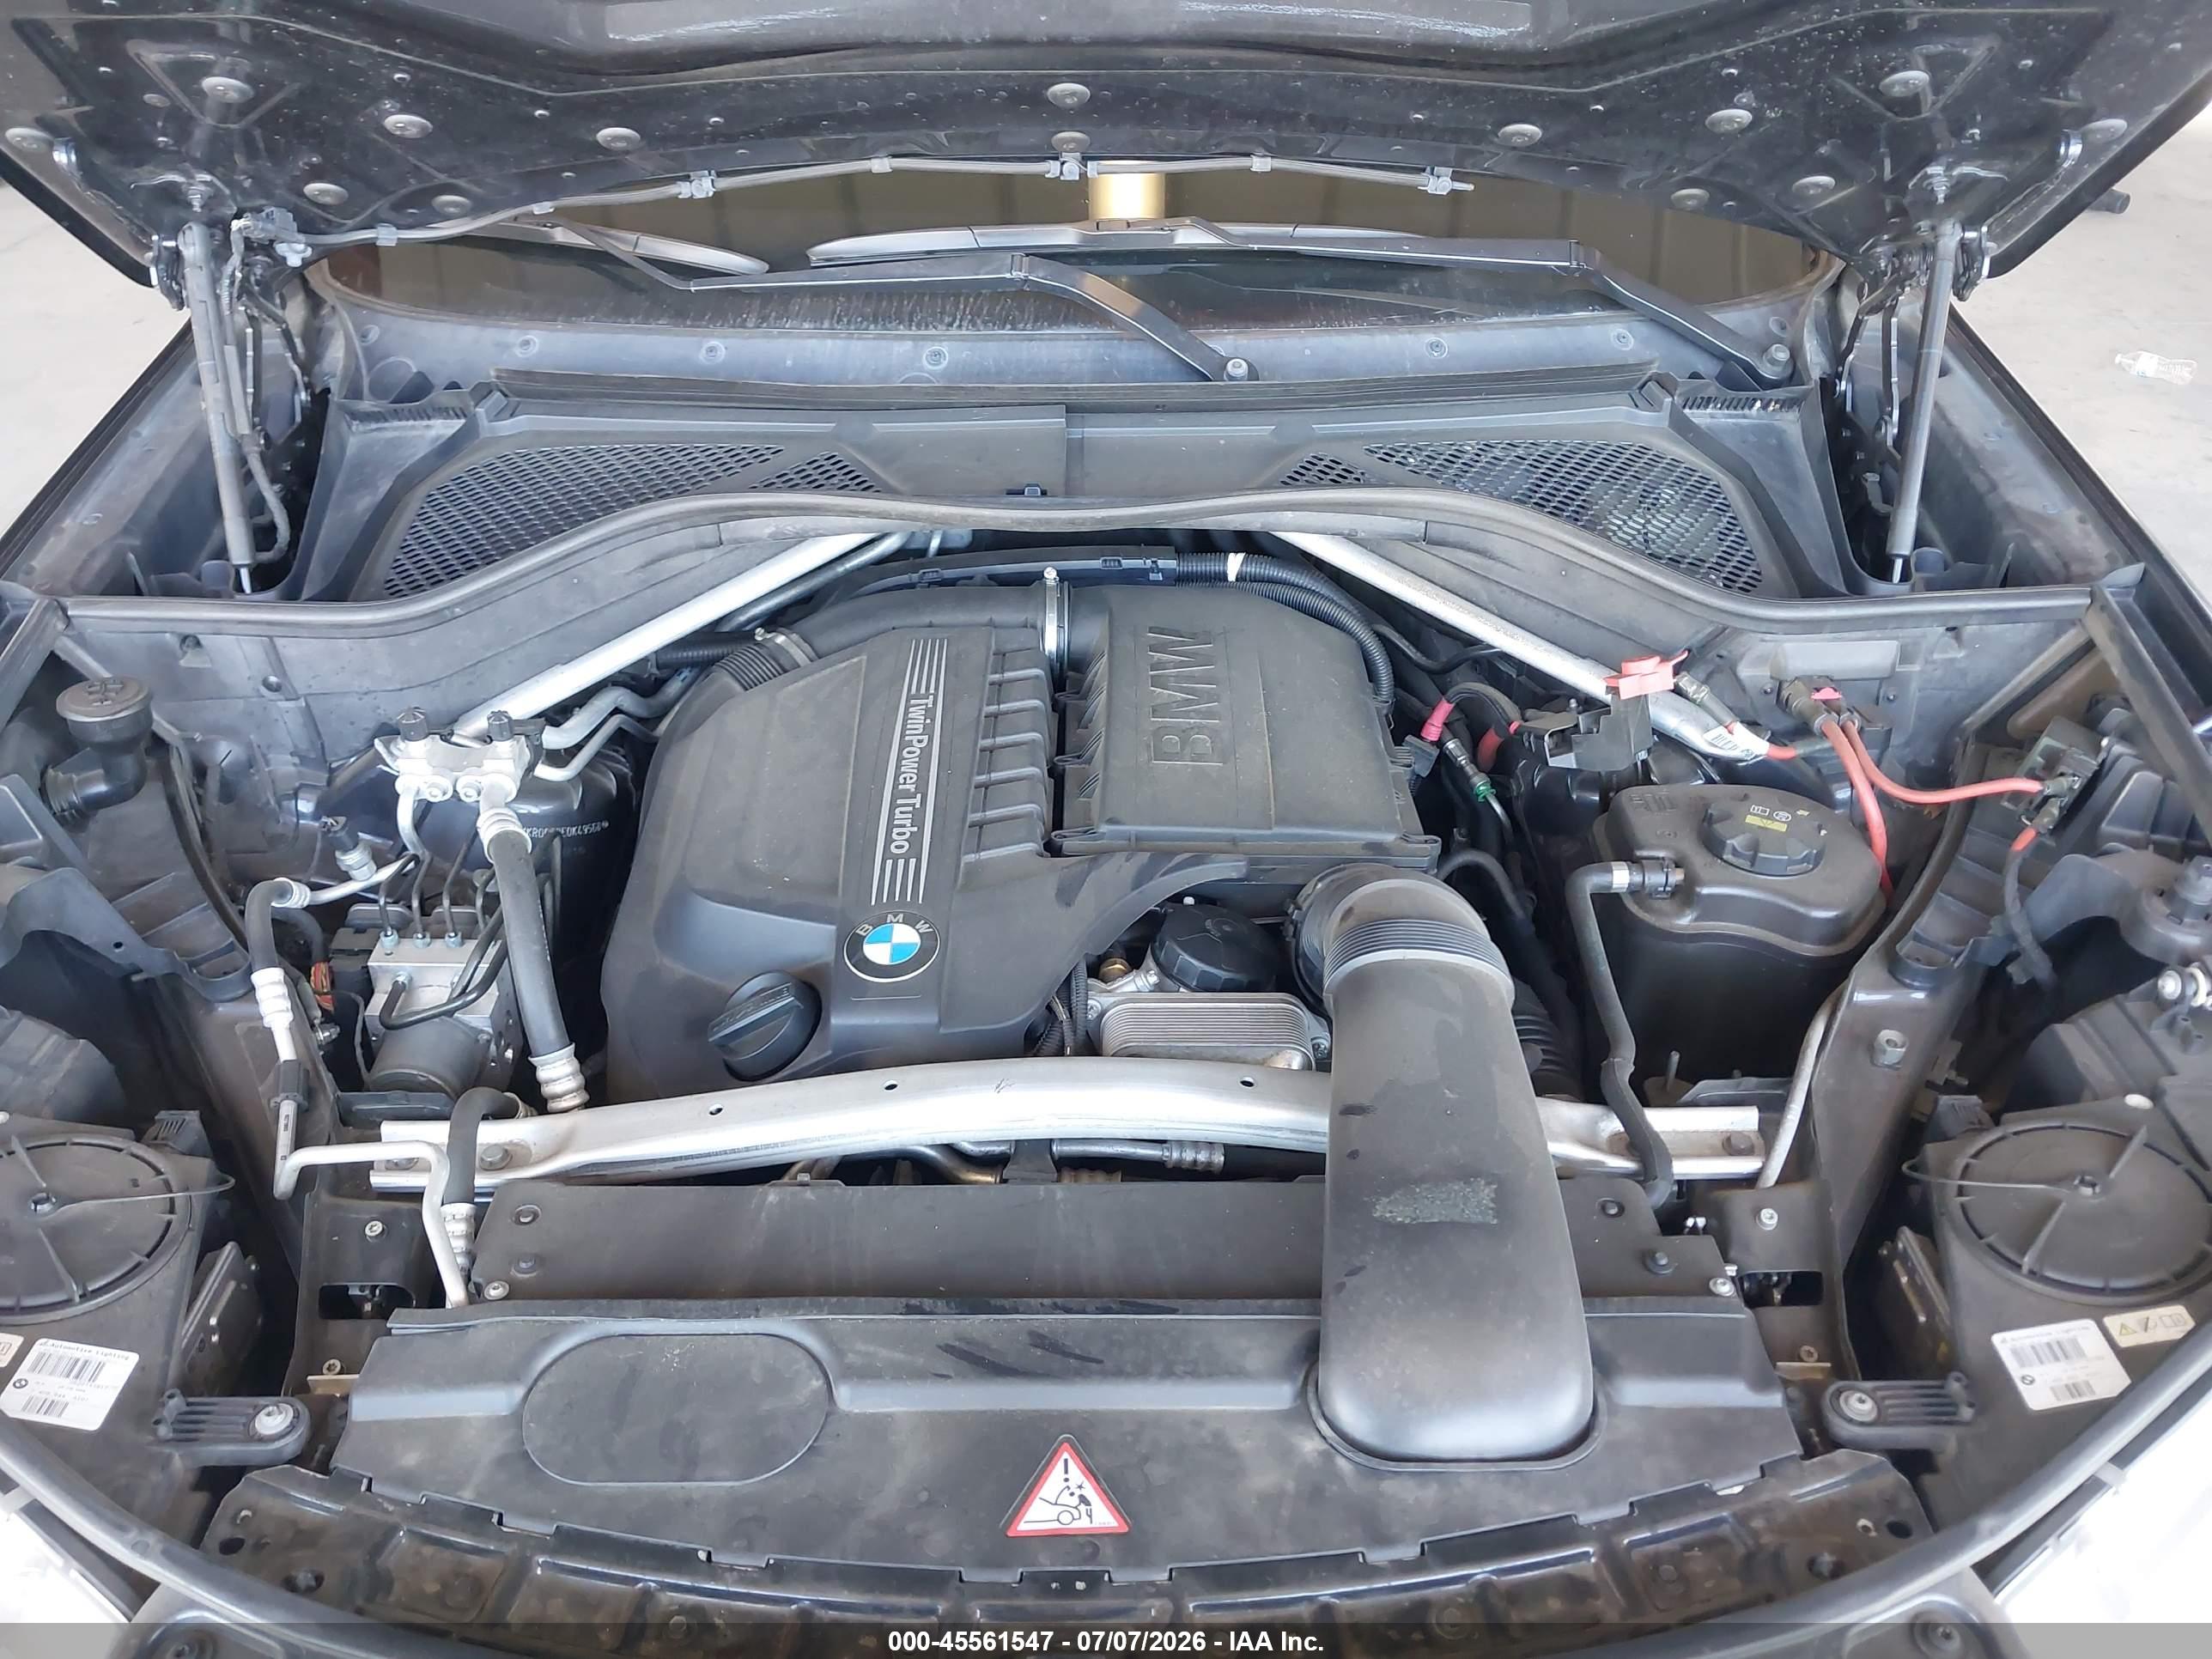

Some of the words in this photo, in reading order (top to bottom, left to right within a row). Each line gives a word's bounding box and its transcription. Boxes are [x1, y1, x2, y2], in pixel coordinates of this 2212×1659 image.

[1146, 626, 1223, 765] BMW
[898, 695, 934, 793] TwinPower
[890, 793, 922, 854] Turbo
[855, 914, 934, 937] BMW
